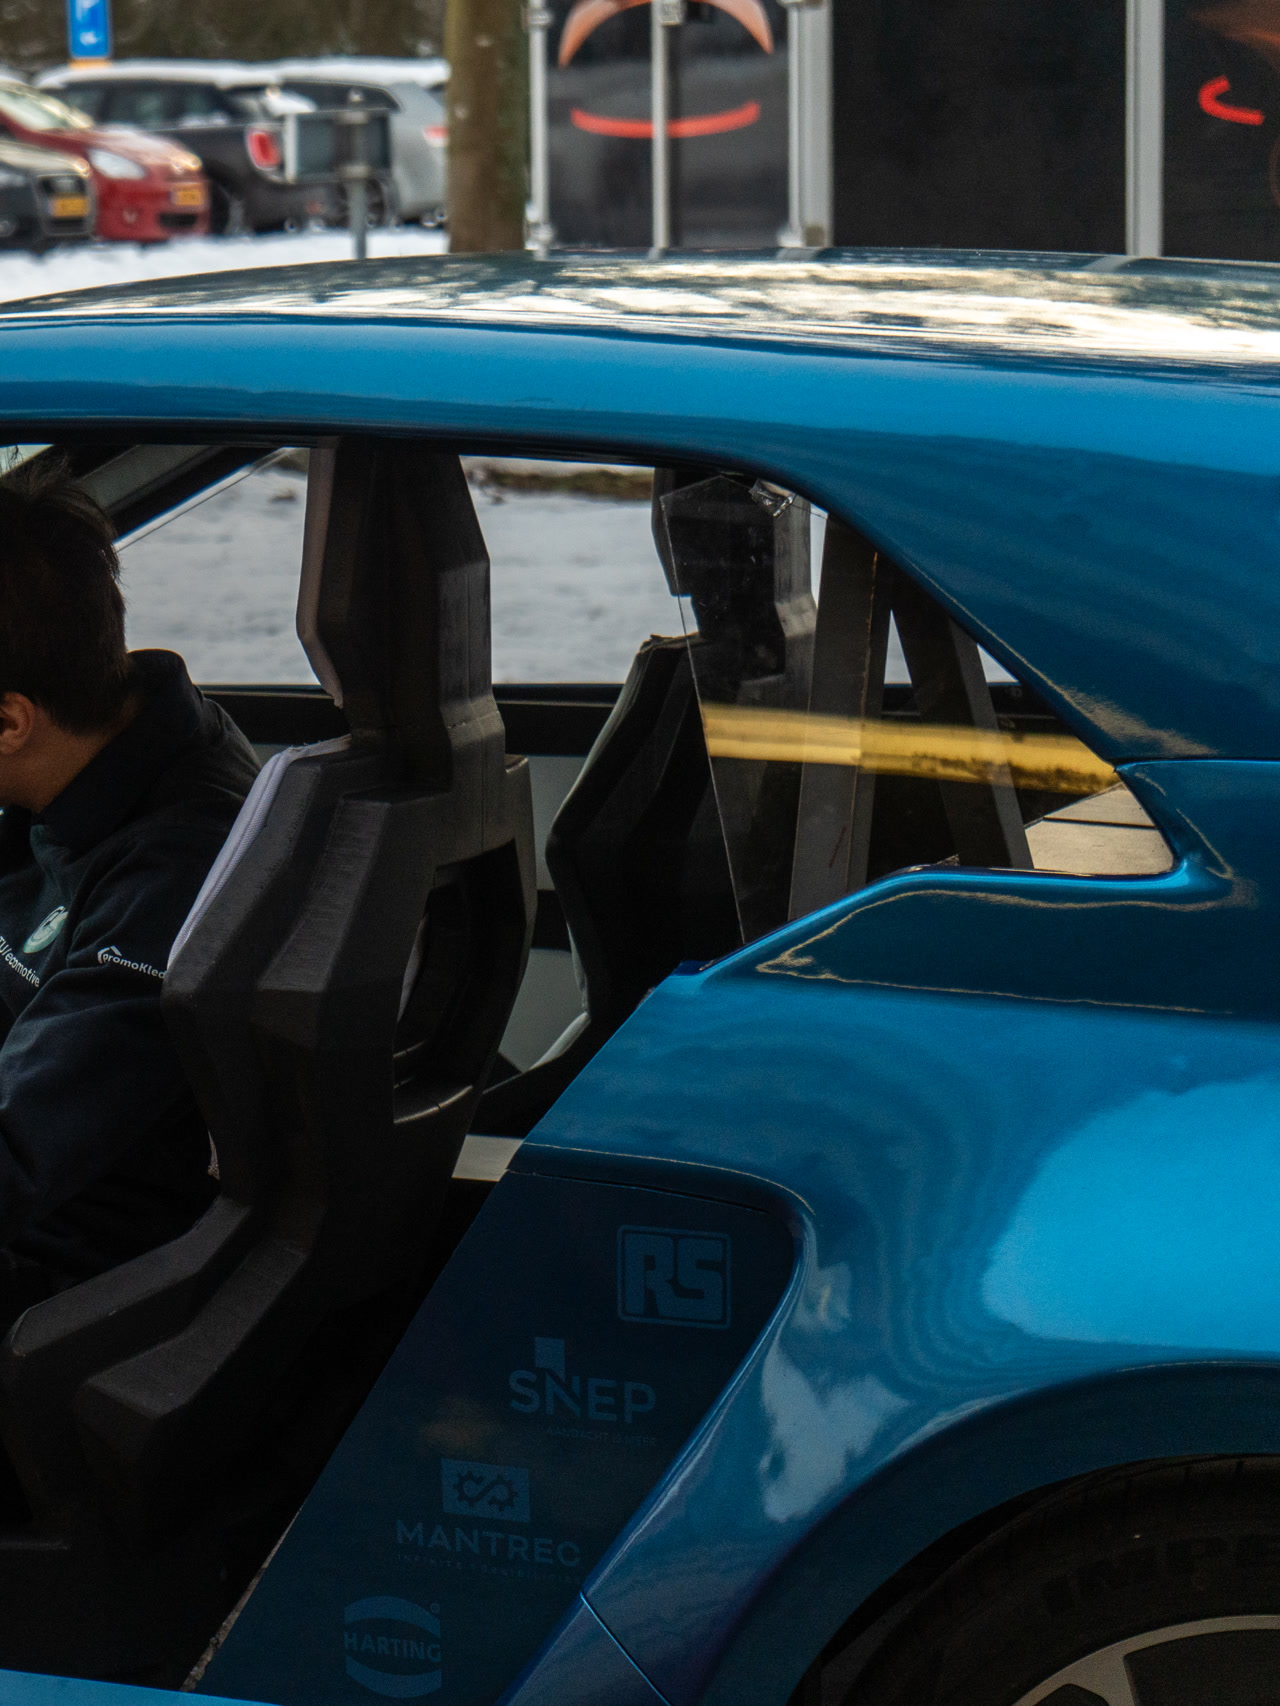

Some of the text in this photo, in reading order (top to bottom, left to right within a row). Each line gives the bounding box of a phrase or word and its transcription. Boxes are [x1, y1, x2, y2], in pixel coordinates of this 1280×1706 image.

[624, 1231, 726, 1320] RS
[508, 1368, 658, 1425] SNEP
[395, 1518, 582, 1566] MANTREC
[343, 1630, 442, 1664] HARTING
